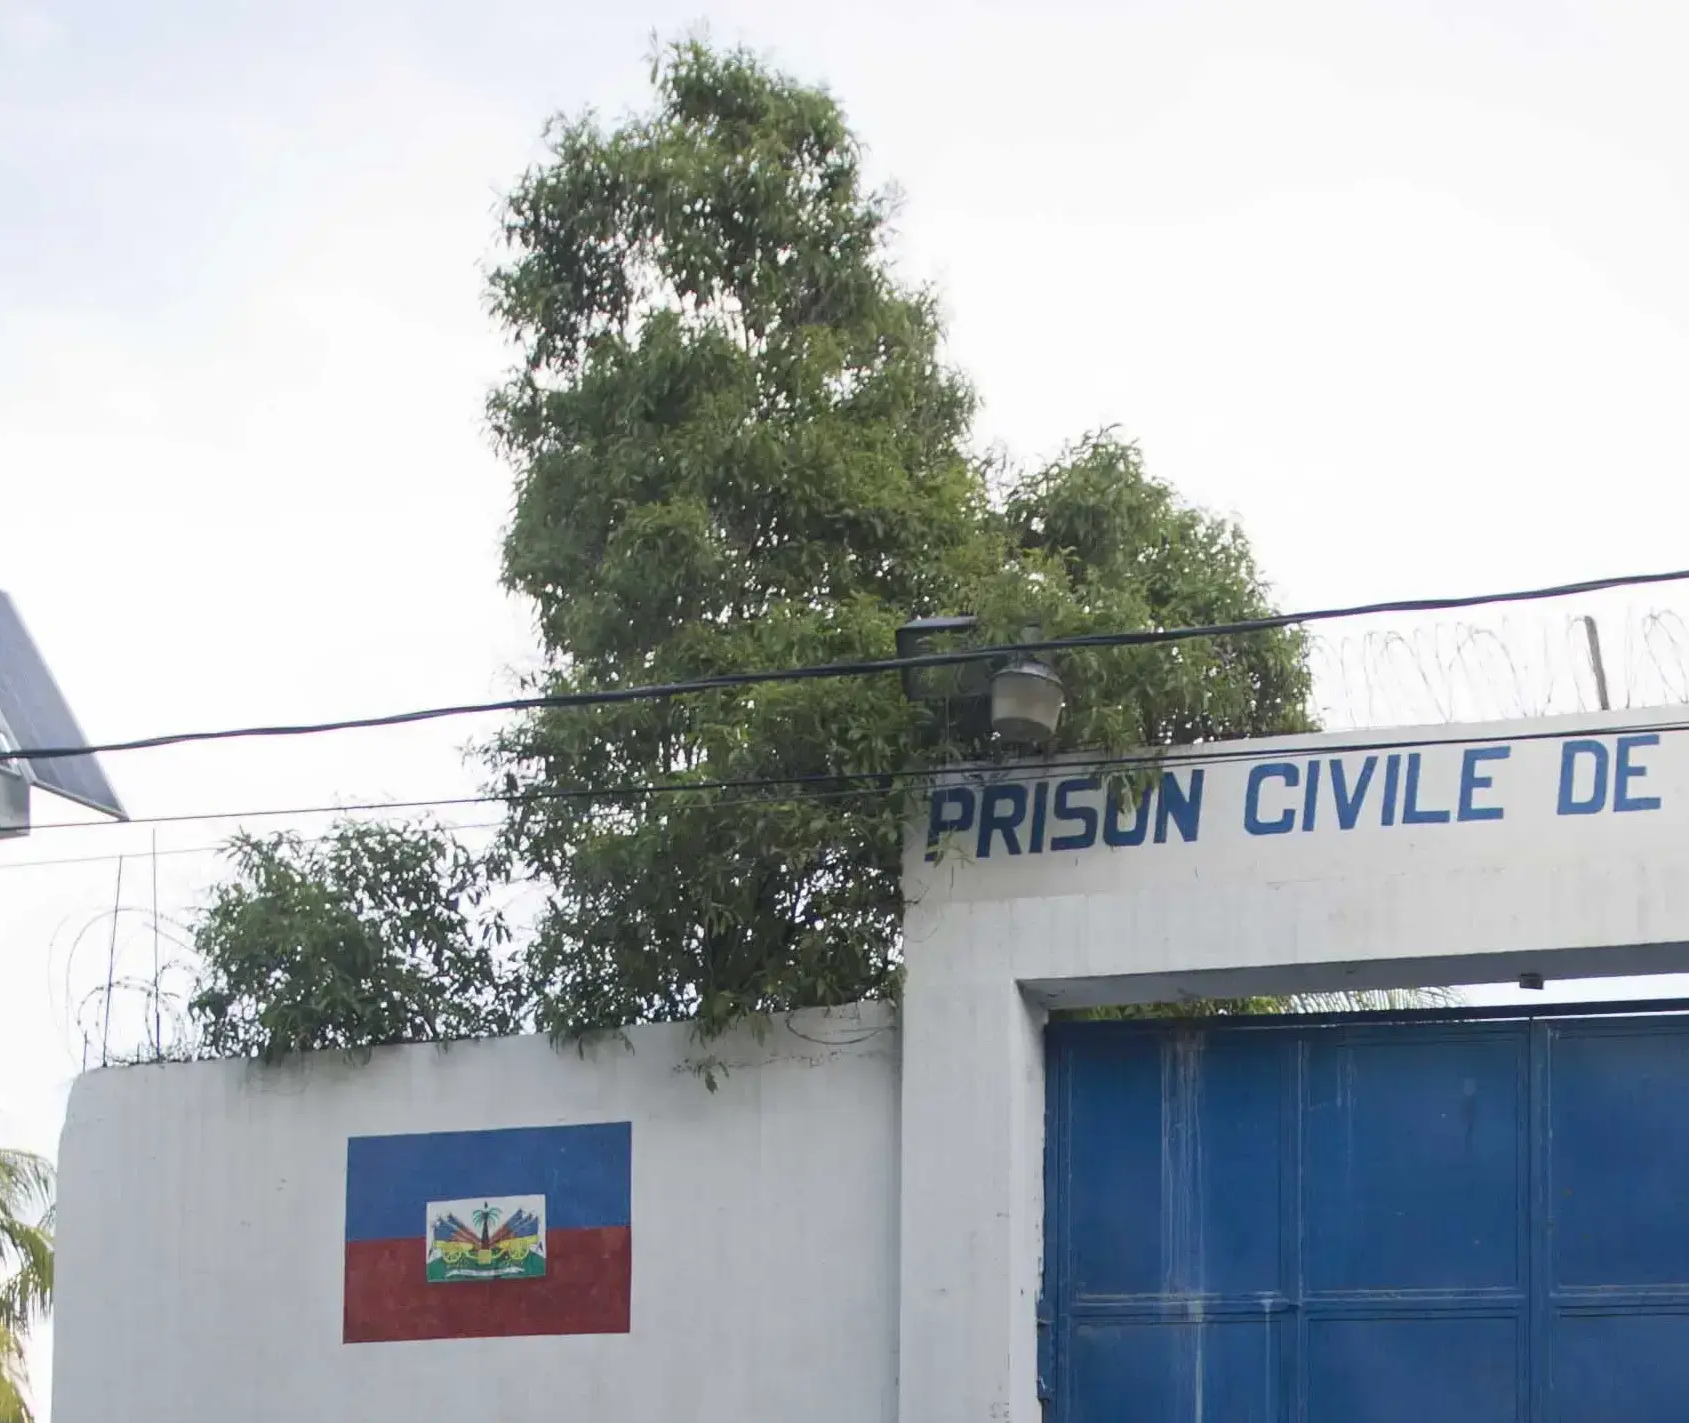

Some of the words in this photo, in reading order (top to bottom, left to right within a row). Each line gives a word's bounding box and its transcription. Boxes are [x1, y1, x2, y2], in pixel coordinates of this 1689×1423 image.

[925, 769, 1204, 862] PRISON
[1244, 746, 1511, 835] CIVILE
[1556, 734, 1661, 815] DE
